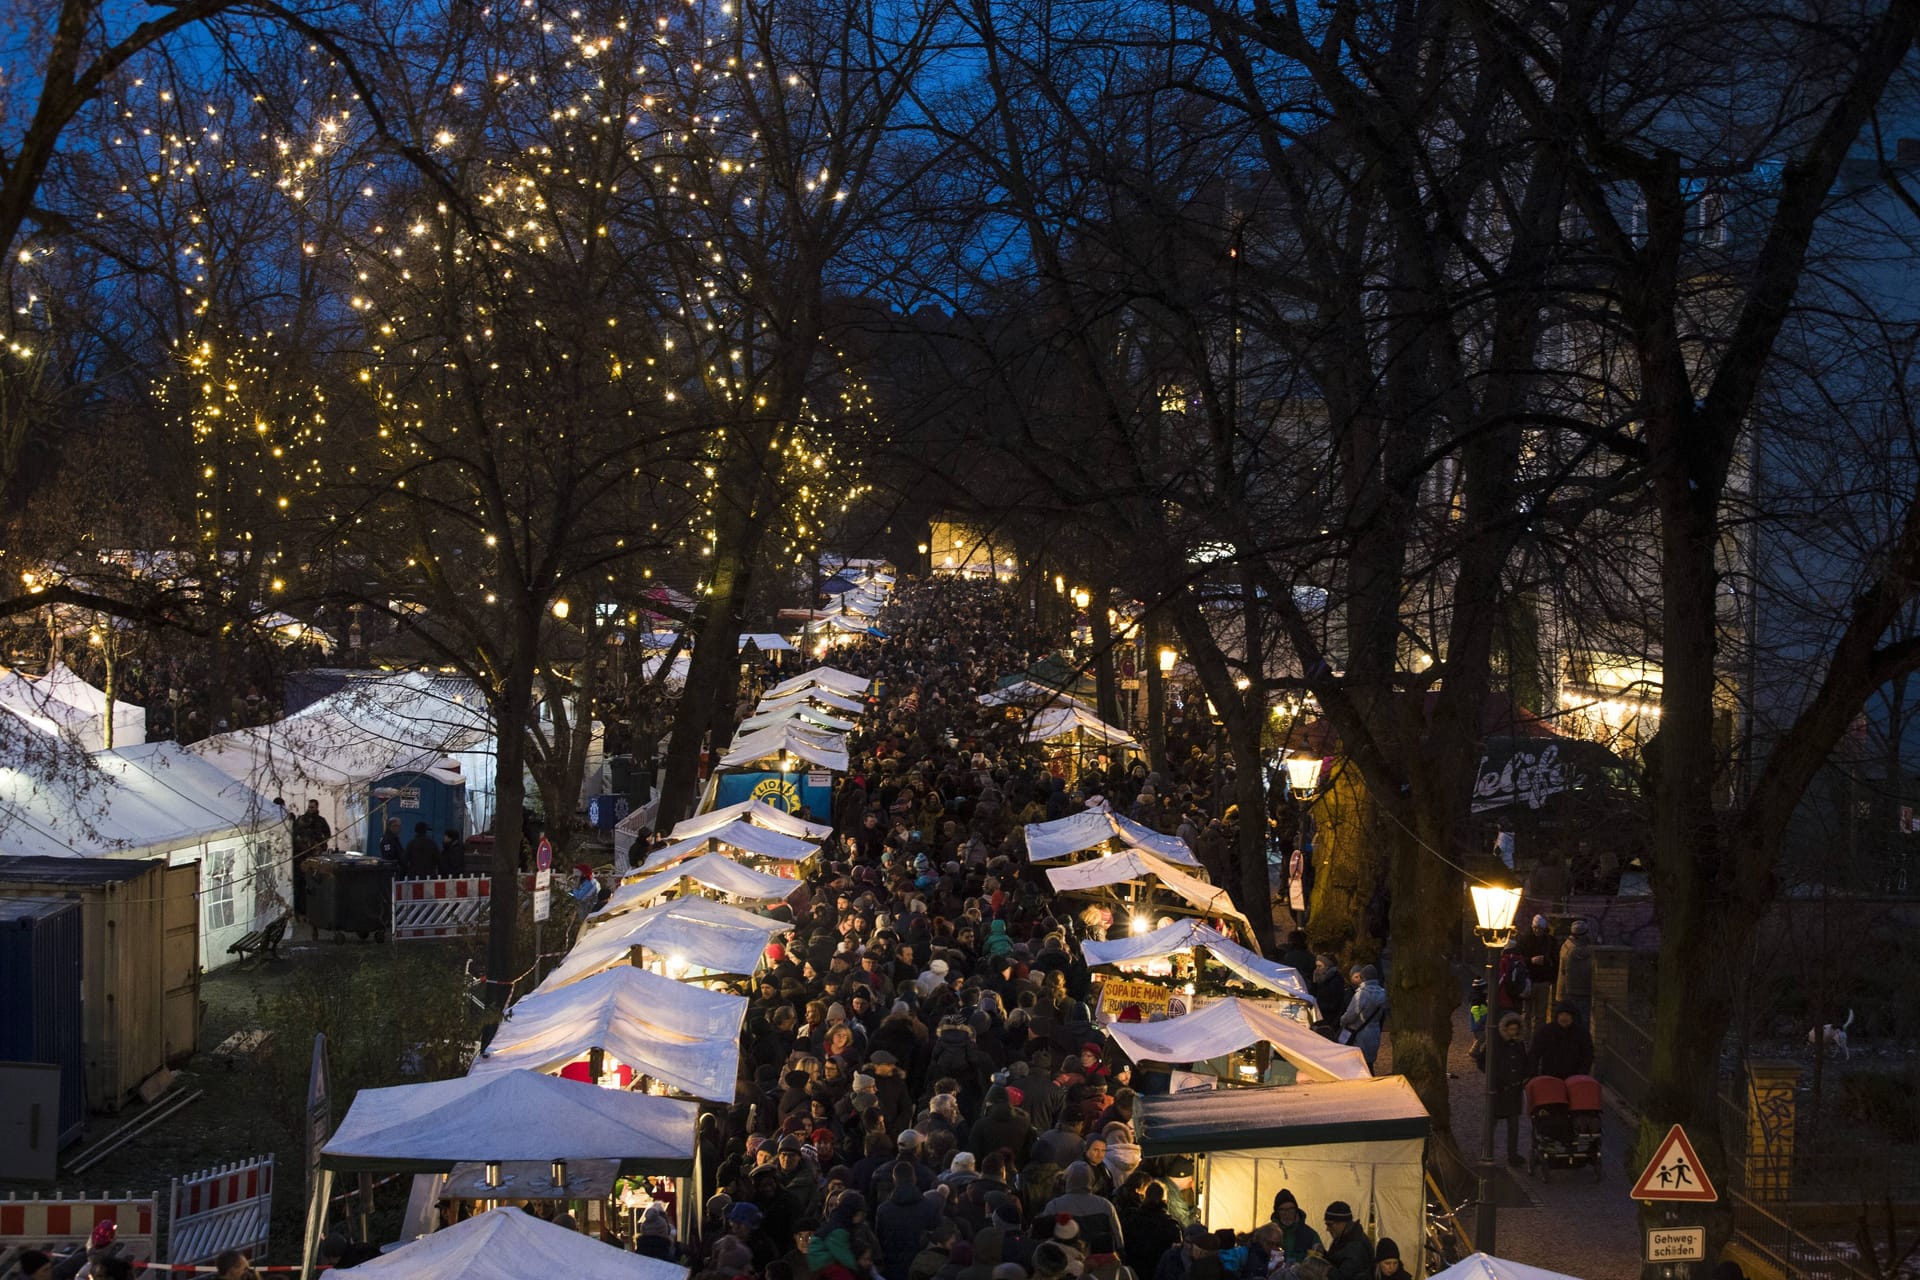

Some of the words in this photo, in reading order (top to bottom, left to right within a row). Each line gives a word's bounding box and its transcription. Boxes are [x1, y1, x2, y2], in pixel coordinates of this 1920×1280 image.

[1106, 984, 1128, 997] SOPA
[1131, 986, 1142, 998] DE
[1654, 1234, 1698, 1245] Gehweg-
